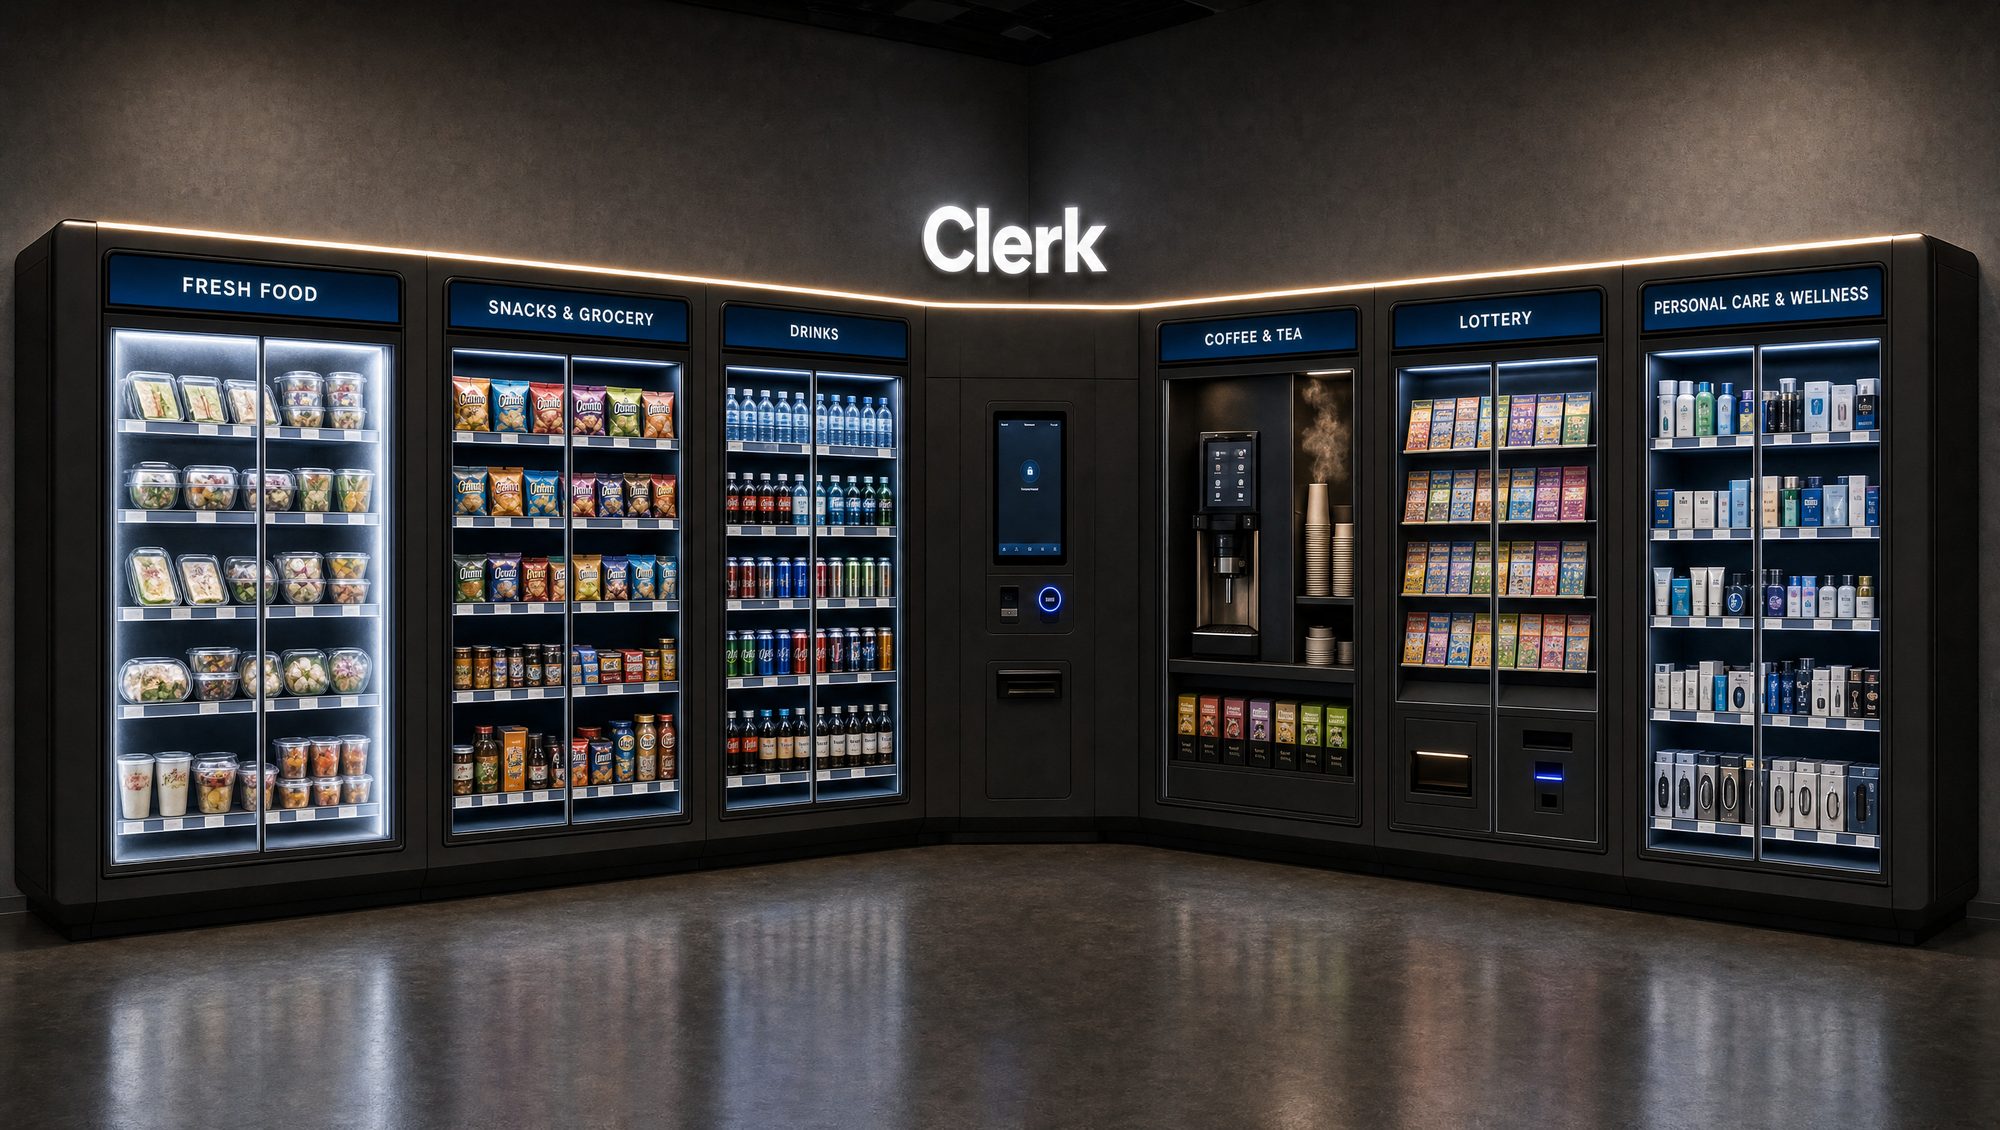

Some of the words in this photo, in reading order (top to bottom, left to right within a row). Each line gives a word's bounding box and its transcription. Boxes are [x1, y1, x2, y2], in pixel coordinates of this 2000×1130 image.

[923, 205, 1107, 275] Clerk
[182, 276, 251, 298] FRESH
[260, 282, 318, 303] FOOD
[1654, 296, 1727, 315] PERSONAL
[1731, 292, 1770, 310] CARE
[1774, 291, 1786, 307] &
[1789, 285, 1869, 305] WELLNESS
[488, 299, 557, 319] SNACKS
[562, 305, 574, 321] &
[579, 307, 654, 326] GROCERY
[1459, 310, 1532, 329] LOTTERY
[790, 324, 839, 341] DRINKS
[1204, 330, 1258, 346] COFFEE
[1262, 329, 1272, 343] &
[1276, 327, 1303, 342] TEA
